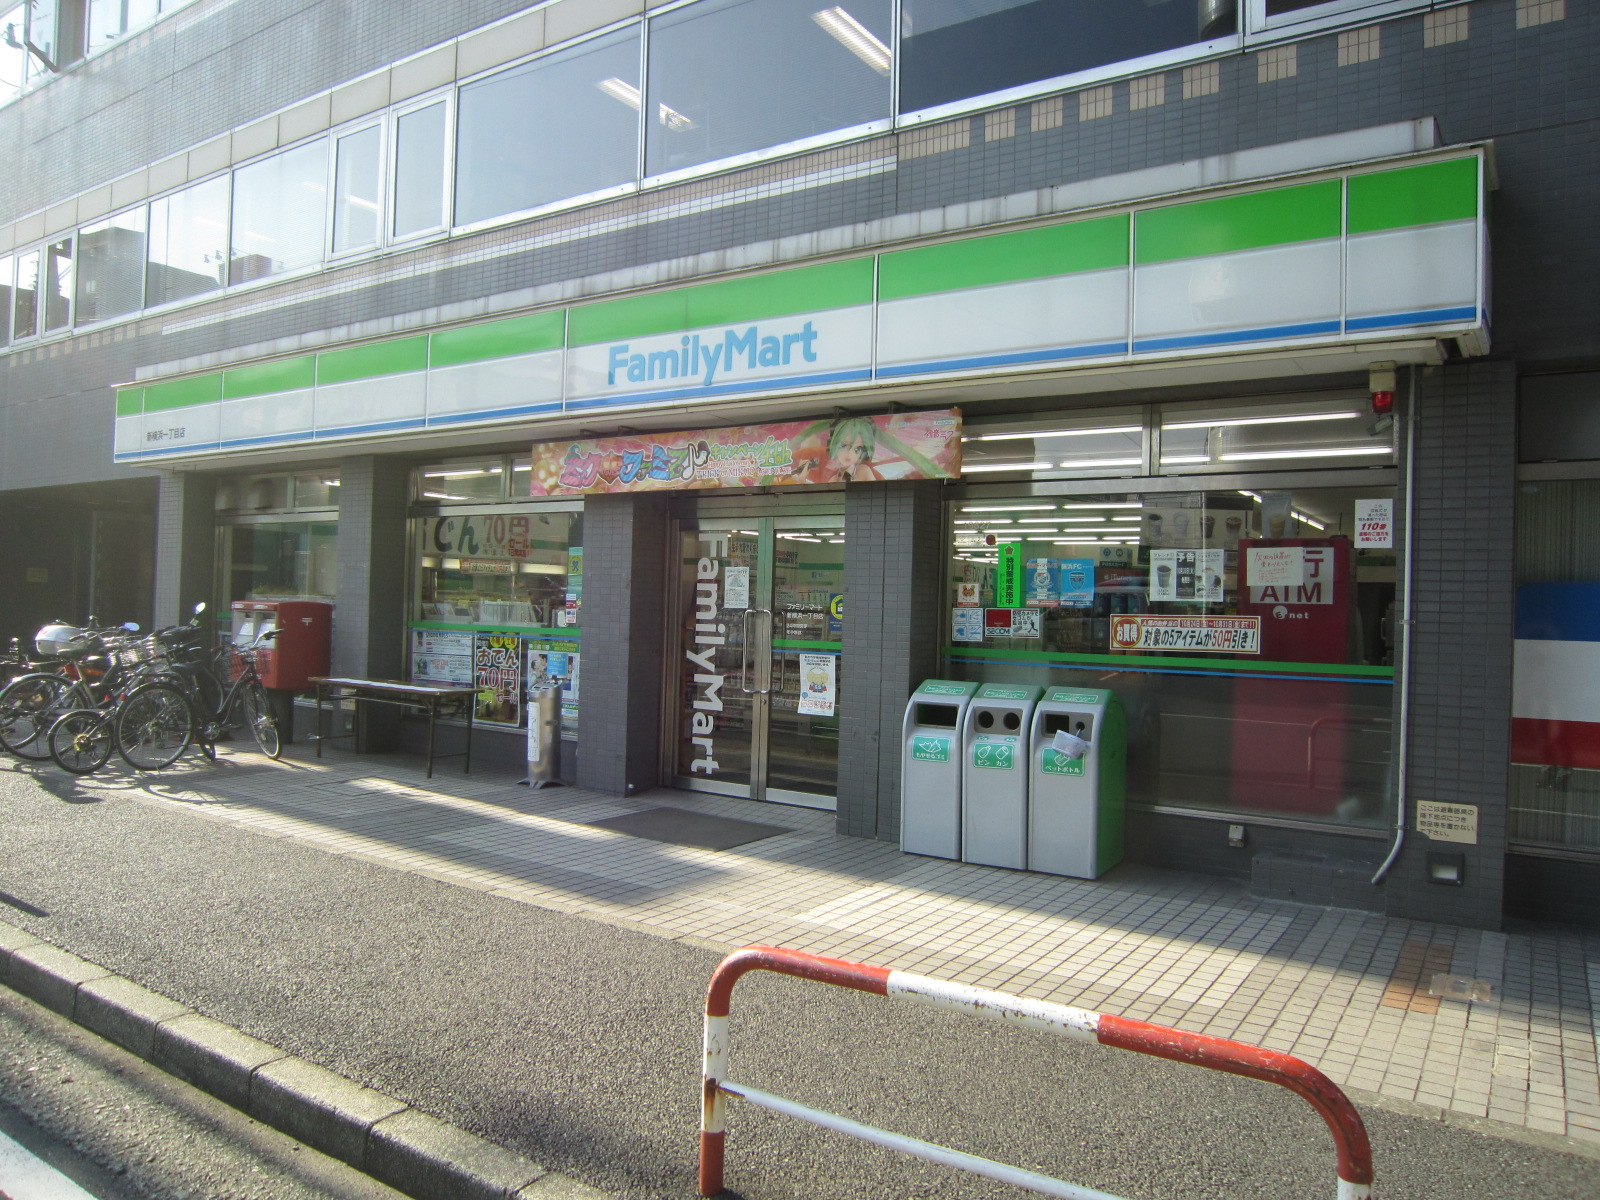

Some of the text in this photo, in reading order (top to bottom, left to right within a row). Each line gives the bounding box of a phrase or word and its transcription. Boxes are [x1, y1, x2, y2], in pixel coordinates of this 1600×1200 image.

[608, 320, 817, 386] FamilyMart
[146, 427, 186, 442] 新横浜一丁目店
[924, 429, 954, 440] 初音ミク
[711, 443, 764, 460] キャンペーン
[1362, 522, 1387, 530] 110番
[1177, 552, 1195, 563] 予告
[787, 603, 823, 611] ファミリーマート
[787, 612, 824, 620] 新横浜一丁目店
[1117, 623, 1138, 642] お買得
[477, 647, 518, 667] おでん
[686, 532, 729, 774] FamilyMart
[477, 666, 518, 692] 70円
[495, 692, 518, 704] セール
[1045, 766, 1081, 774] ペットボトル
[1420, 804, 1474, 815] ここは避難器具の
[1420, 813, 1466, 822] 降下地点につき
[1420, 820, 1474, 831] 物品等を置かない
